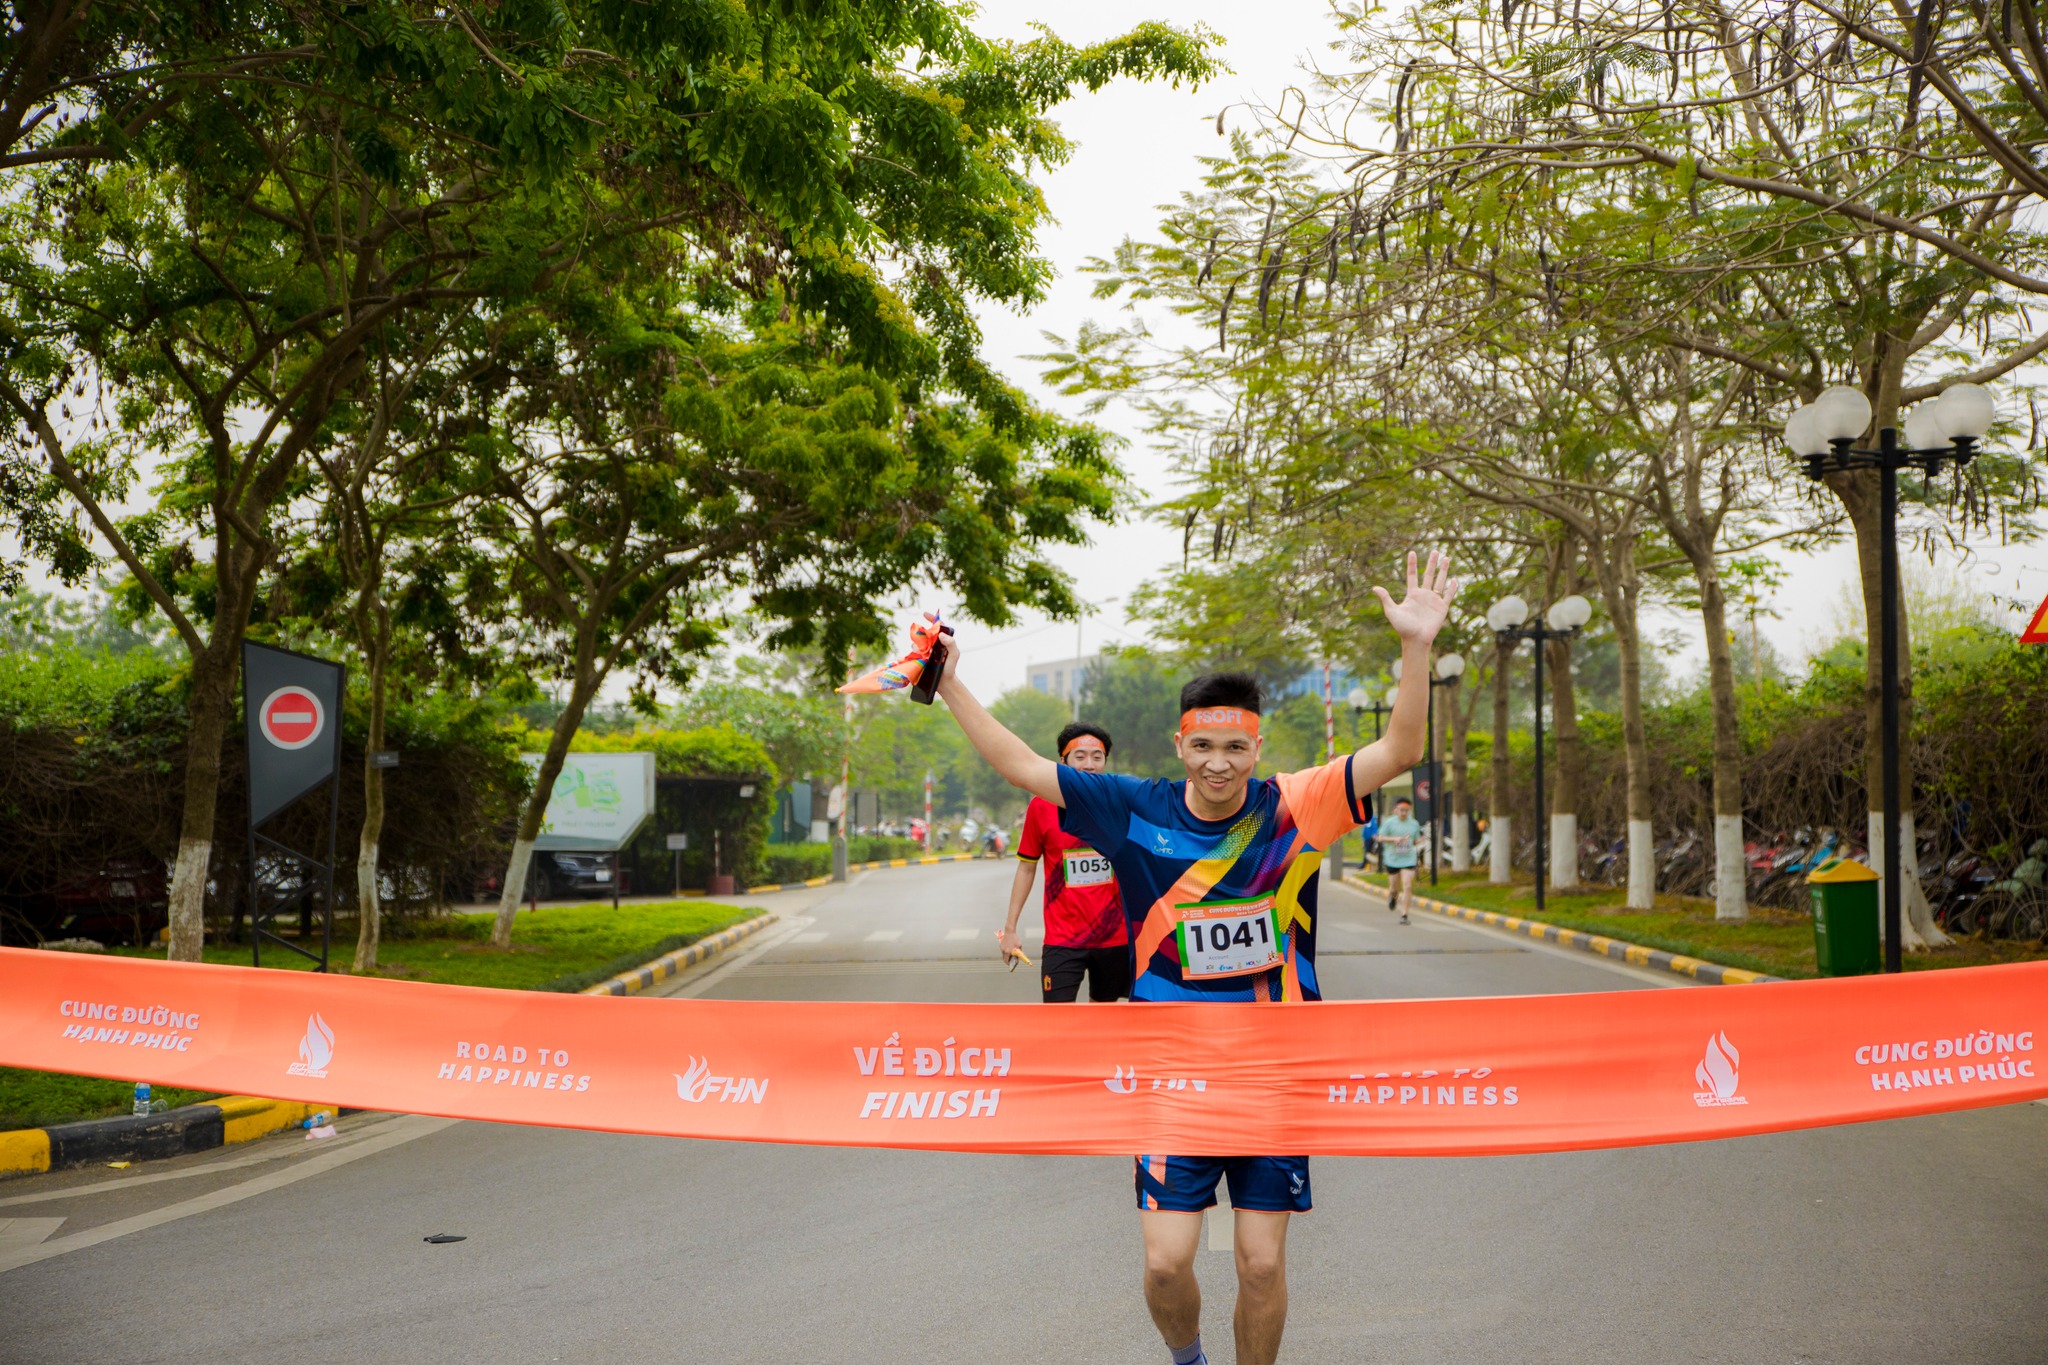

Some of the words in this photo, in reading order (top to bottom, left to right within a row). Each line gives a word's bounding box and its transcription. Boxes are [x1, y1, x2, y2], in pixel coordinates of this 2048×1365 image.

[1195, 709, 1242, 724] FSOFT
[1070, 858, 1110, 874] 1053
[1190, 917, 1268, 953] 1041
[60, 1000, 119, 1022] CUNG
[121, 1005, 200, 1031] ĐƯỜNG
[61, 1024, 130, 1043] HẠNH
[130, 1030, 193, 1052] PHÚC
[1855, 1041, 1929, 1065] CUNG
[1933, 1029, 2033, 1059] ĐƯỜNG
[456, 1041, 527, 1064] ROAD
[538, 1048, 570, 1067] TO
[854, 1032, 906, 1077] VỀ
[913, 1037, 1012, 1078] ĐÍCH
[437, 1063, 591, 1092] HAPPINESS
[1871, 1066, 1954, 1092] HẠNH
[1958, 1055, 2035, 1083] PHÚC
[700, 1076, 769, 1104] FHN
[858, 1089, 1002, 1120] FINISH
[1328, 1085, 1519, 1105] HAPPINESS
